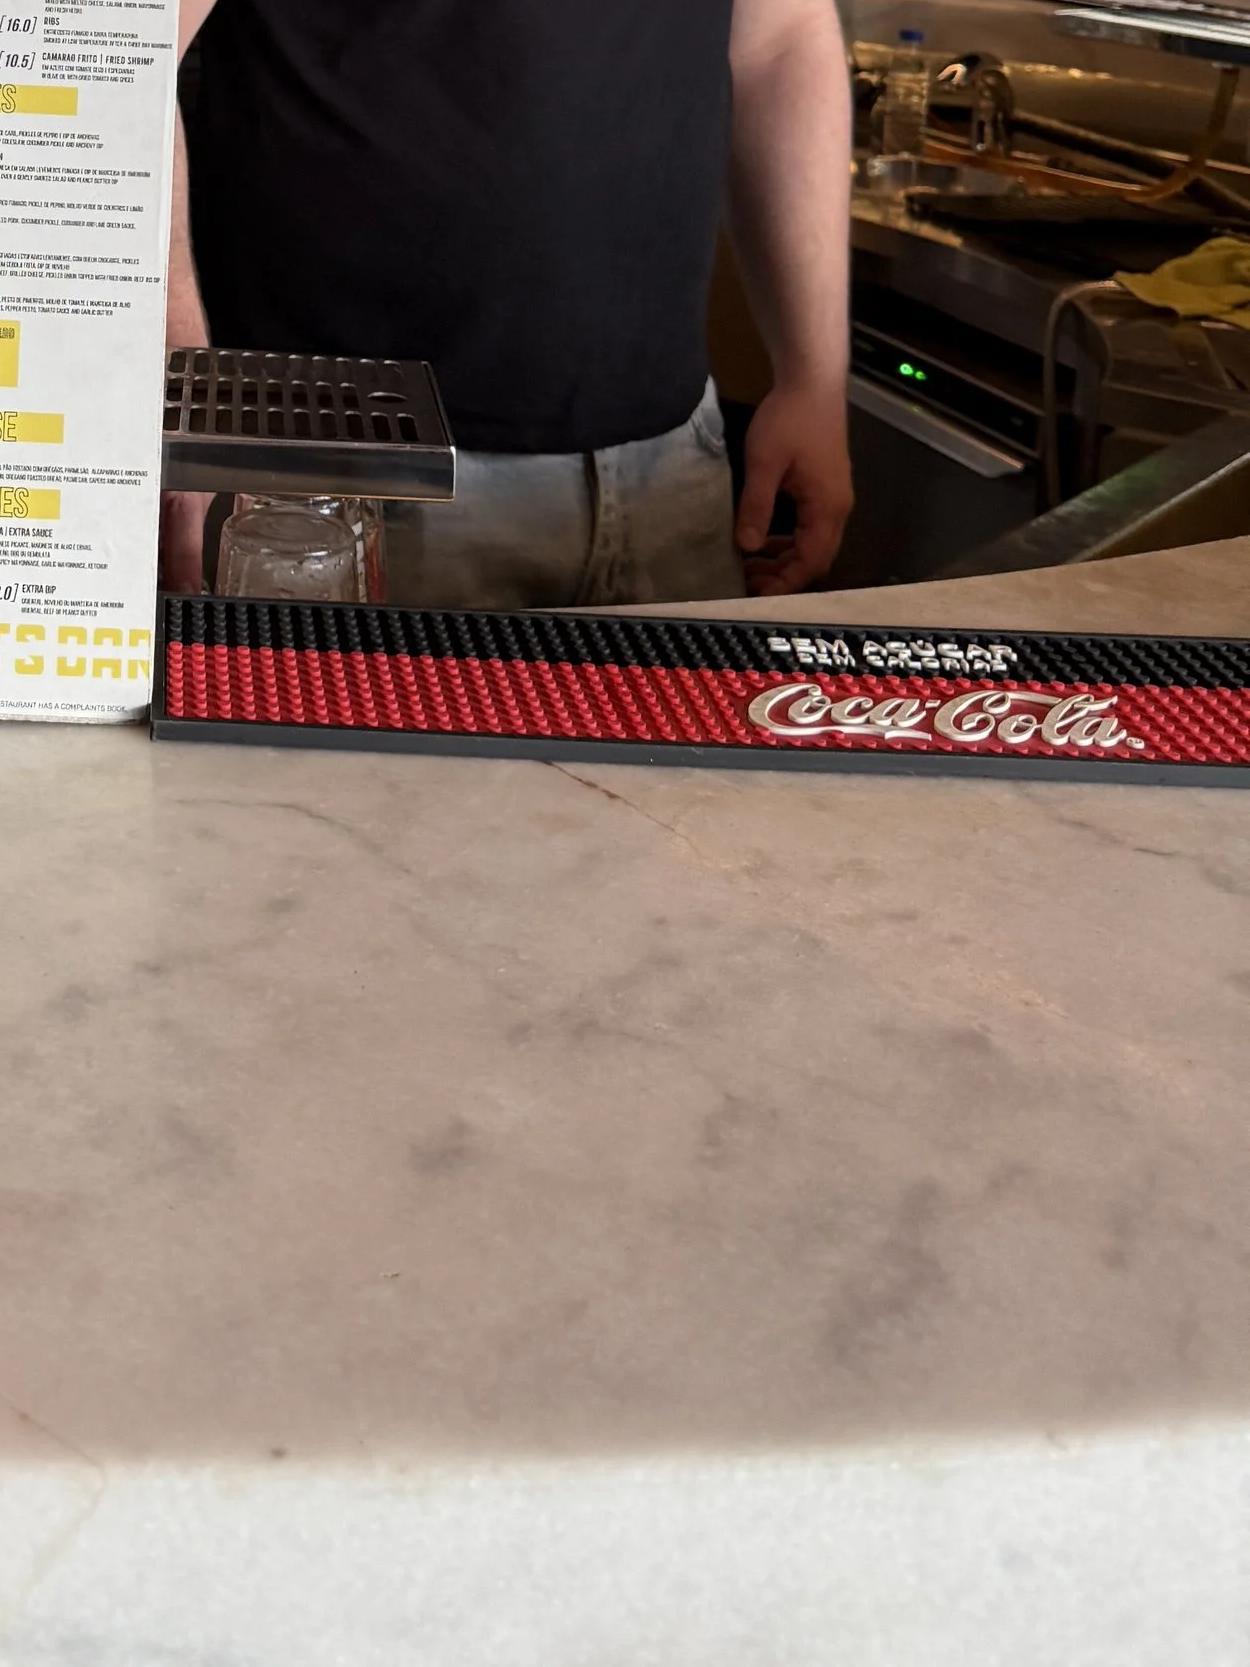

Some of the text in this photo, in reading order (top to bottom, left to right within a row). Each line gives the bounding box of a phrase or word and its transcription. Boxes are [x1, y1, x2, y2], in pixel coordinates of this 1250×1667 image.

[43, 16, 59, 25] RIBS
[77, 53, 97, 62] FRITO
[105, 55, 125, 64] FRIED
[127, 56, 154, 65] SHRIMP
[21, 583, 43, 593] EXTRA
[767, 636, 850, 656] SEM
[748, 682, 1128, 748] Coca-Cola
